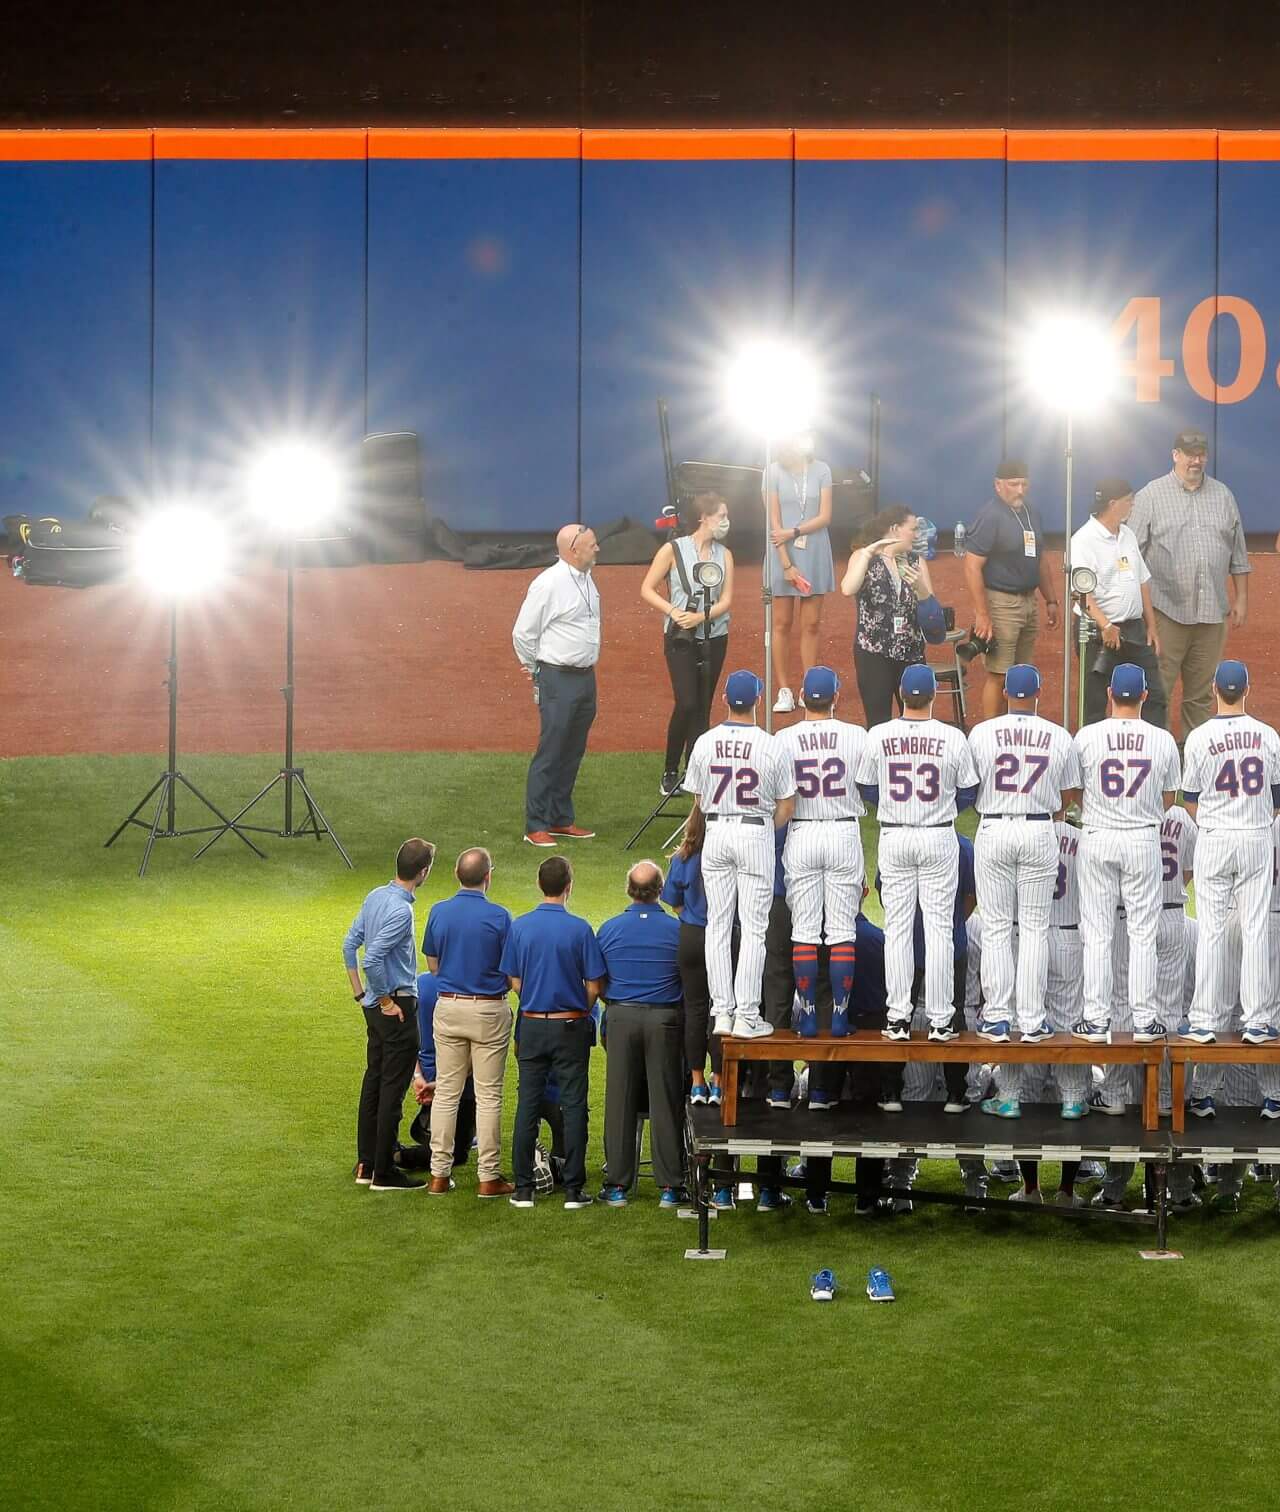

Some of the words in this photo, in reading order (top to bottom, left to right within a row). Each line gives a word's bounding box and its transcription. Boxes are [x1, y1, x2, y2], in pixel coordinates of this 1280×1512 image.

[715, 740, 752, 760] REED
[798, 731, 838, 752] HAND
[881, 736, 946, 758] HEMBREE
[995, 728, 1052, 750] FAMILIA
[1106, 732, 1145, 752] LUGO
[1207, 731, 1262, 756] deGROM
[709, 765, 760, 806] 72
[794, 757, 847, 799] 52
[888, 762, 940, 802] 53
[994, 753, 1050, 794] 27
[1100, 758, 1152, 798] 67
[1214, 755, 1264, 798] 48
